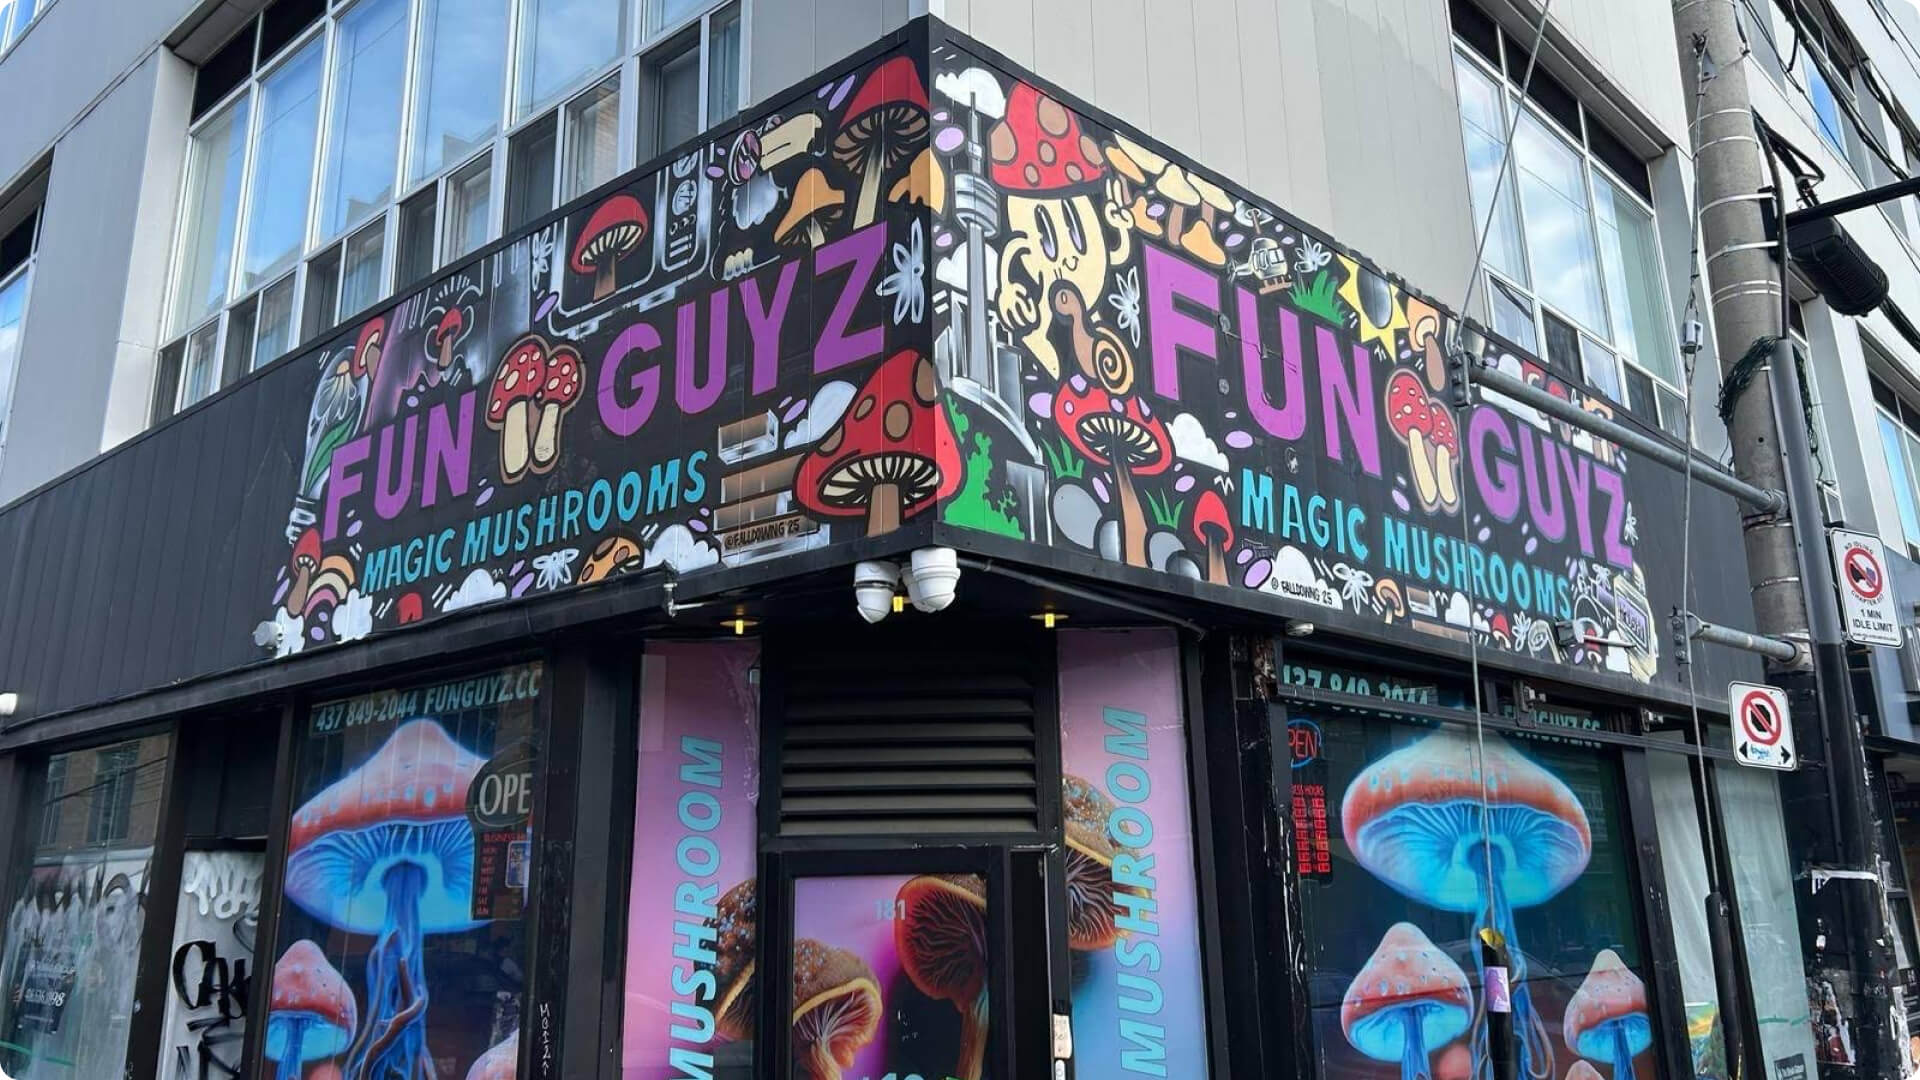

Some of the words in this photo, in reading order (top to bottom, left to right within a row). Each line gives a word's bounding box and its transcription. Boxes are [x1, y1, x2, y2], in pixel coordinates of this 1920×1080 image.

[323, 391, 476, 542] FUN
[597, 221, 887, 437] GUYZ
[1145, 244, 1382, 478] FUN
[1469, 406, 1632, 570] GUYZ
[361, 528, 456, 596] MAGIC
[461, 450, 708, 568] MUSHROOMS
[1242, 468, 1368, 562] MAGIC
[1384, 515, 1572, 620] MUSHROOMS
[1852, 619, 1874, 630] IDLE
[1874, 621, 1893, 633] LIMIT
[1867, 609, 1882, 619] MIN
[316, 704, 344, 732] 437
[346, 691, 417, 727] 849-2044
[669, 735, 723, 1080] MUSHROOM
[874, 900, 905, 920] 181
[1103, 705, 1169, 1079] MUSHROOM
